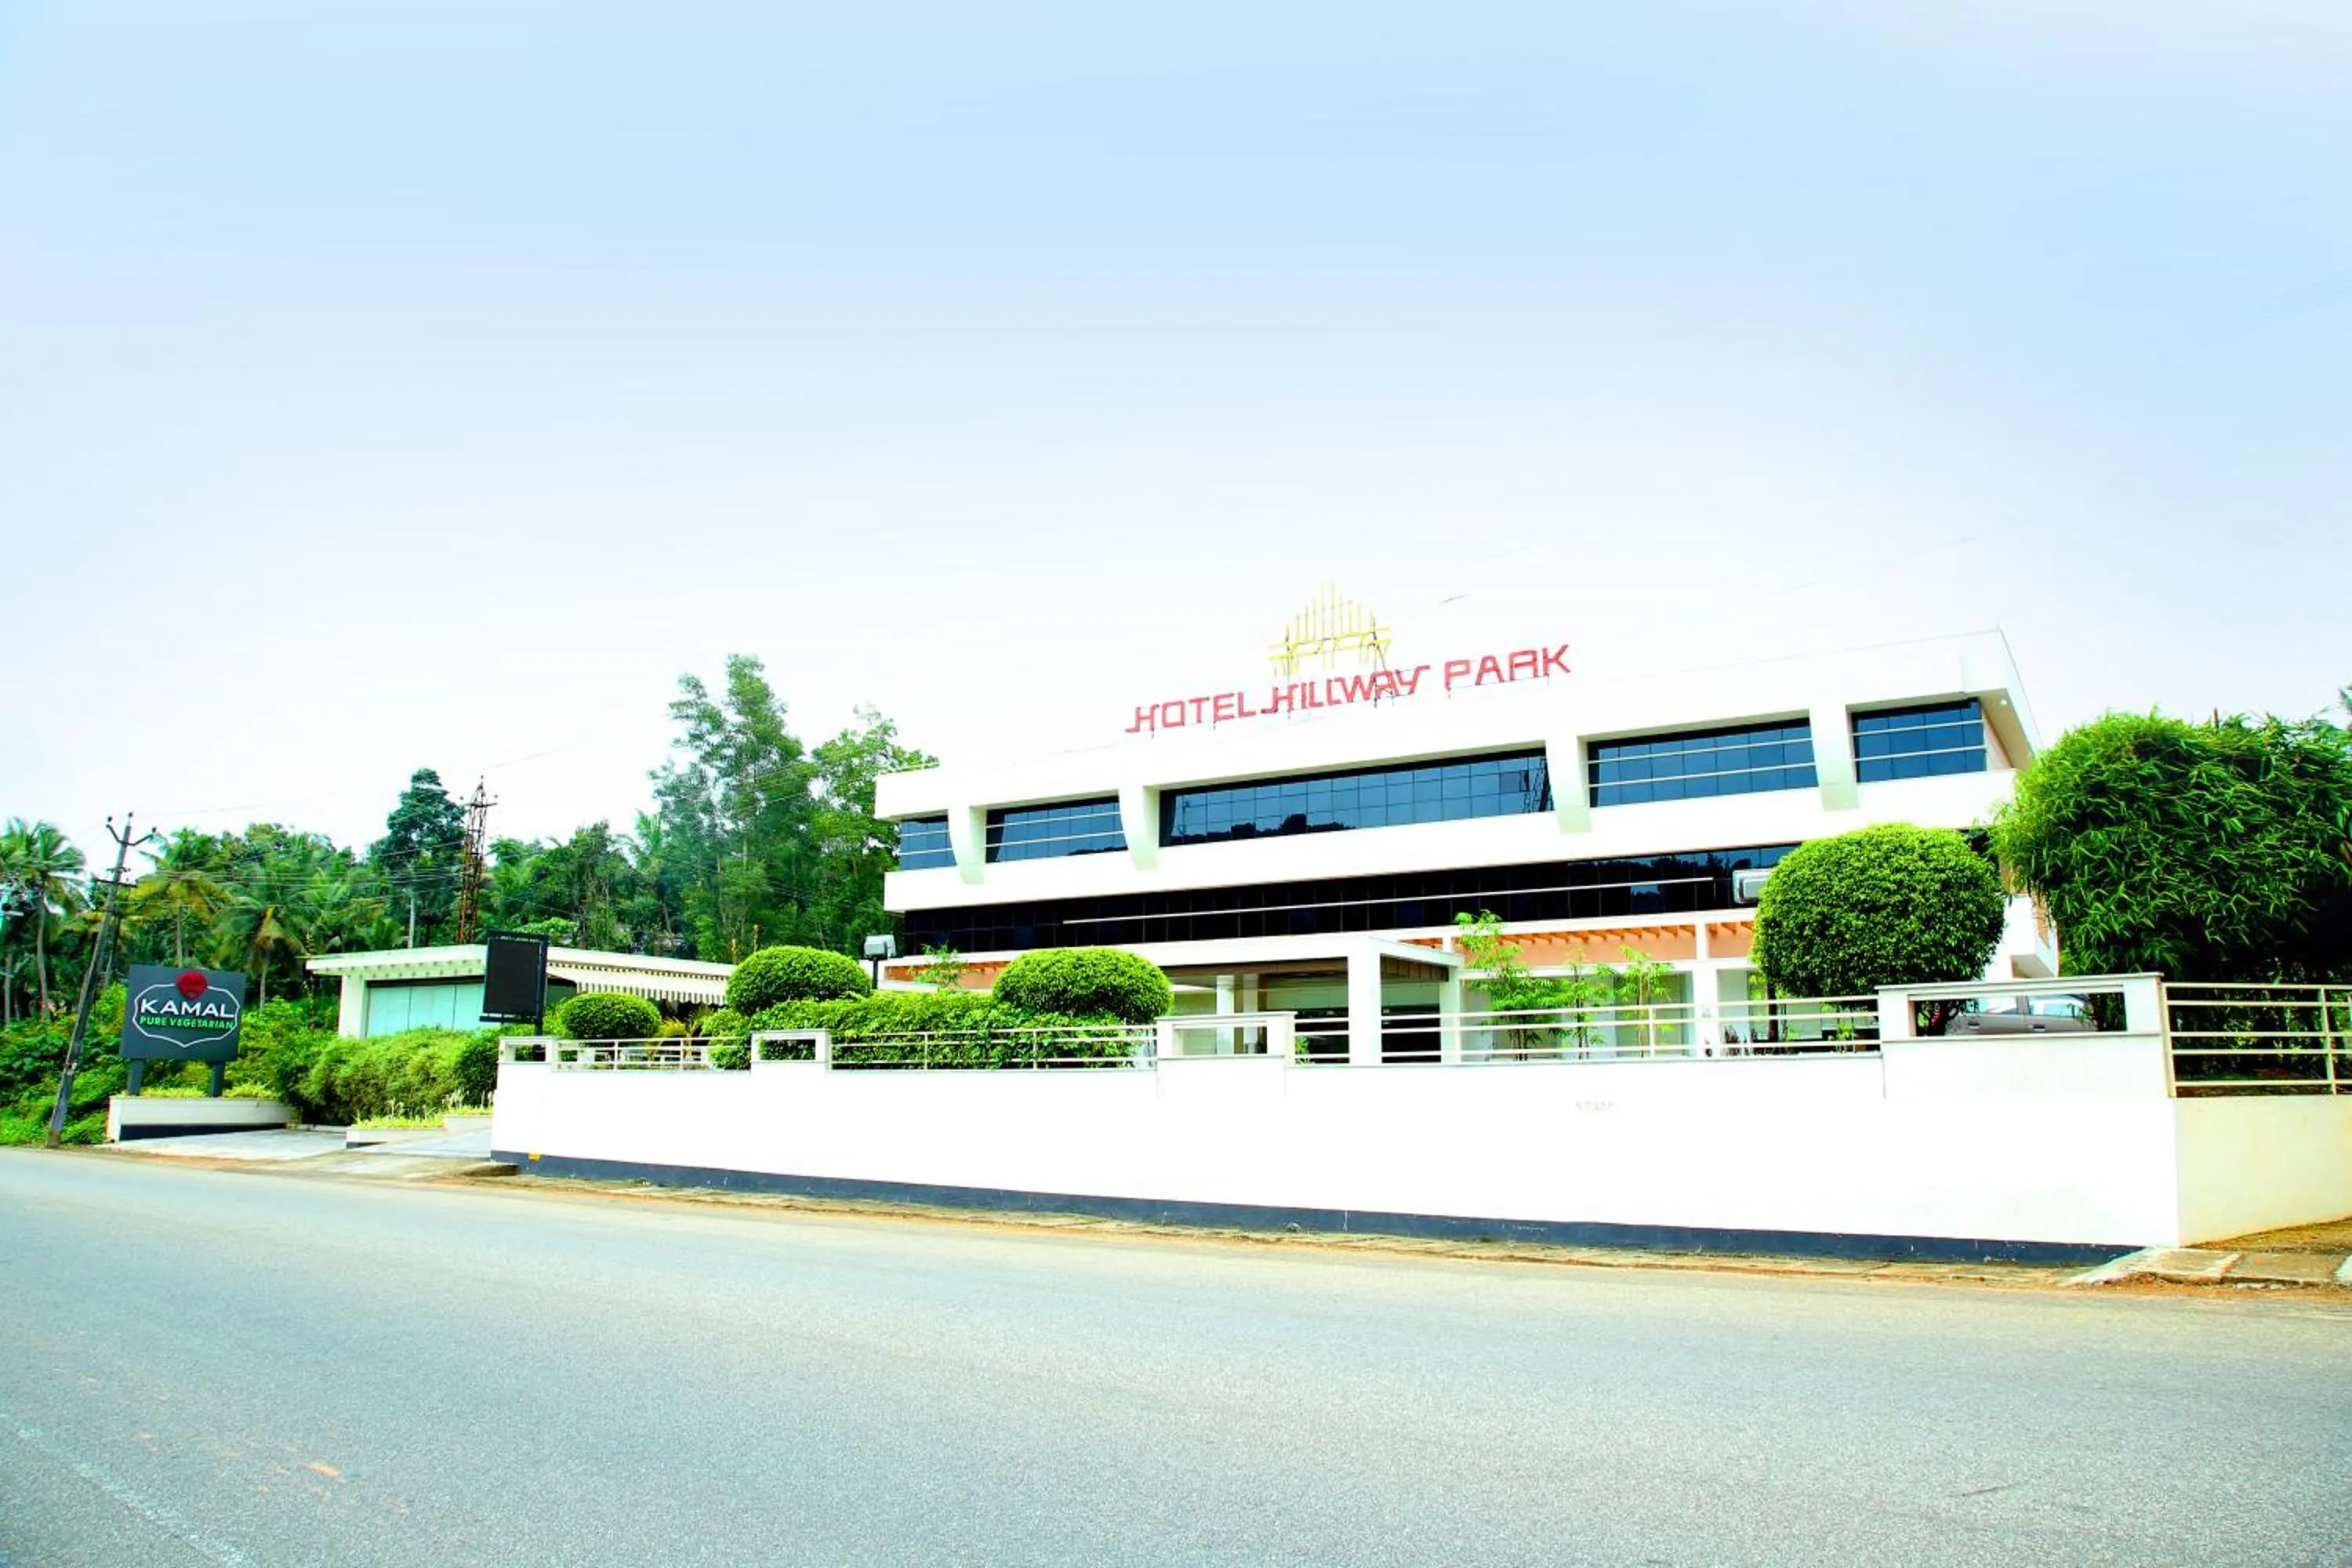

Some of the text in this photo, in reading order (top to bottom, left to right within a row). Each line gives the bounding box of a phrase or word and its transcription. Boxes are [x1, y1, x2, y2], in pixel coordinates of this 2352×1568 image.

[1125, 644, 1571, 733] HOTEL HILLWAY PARK
[140, 999, 234, 1018] KAMAL
[140, 1015, 234, 1030] PURE VEGETARIAN
